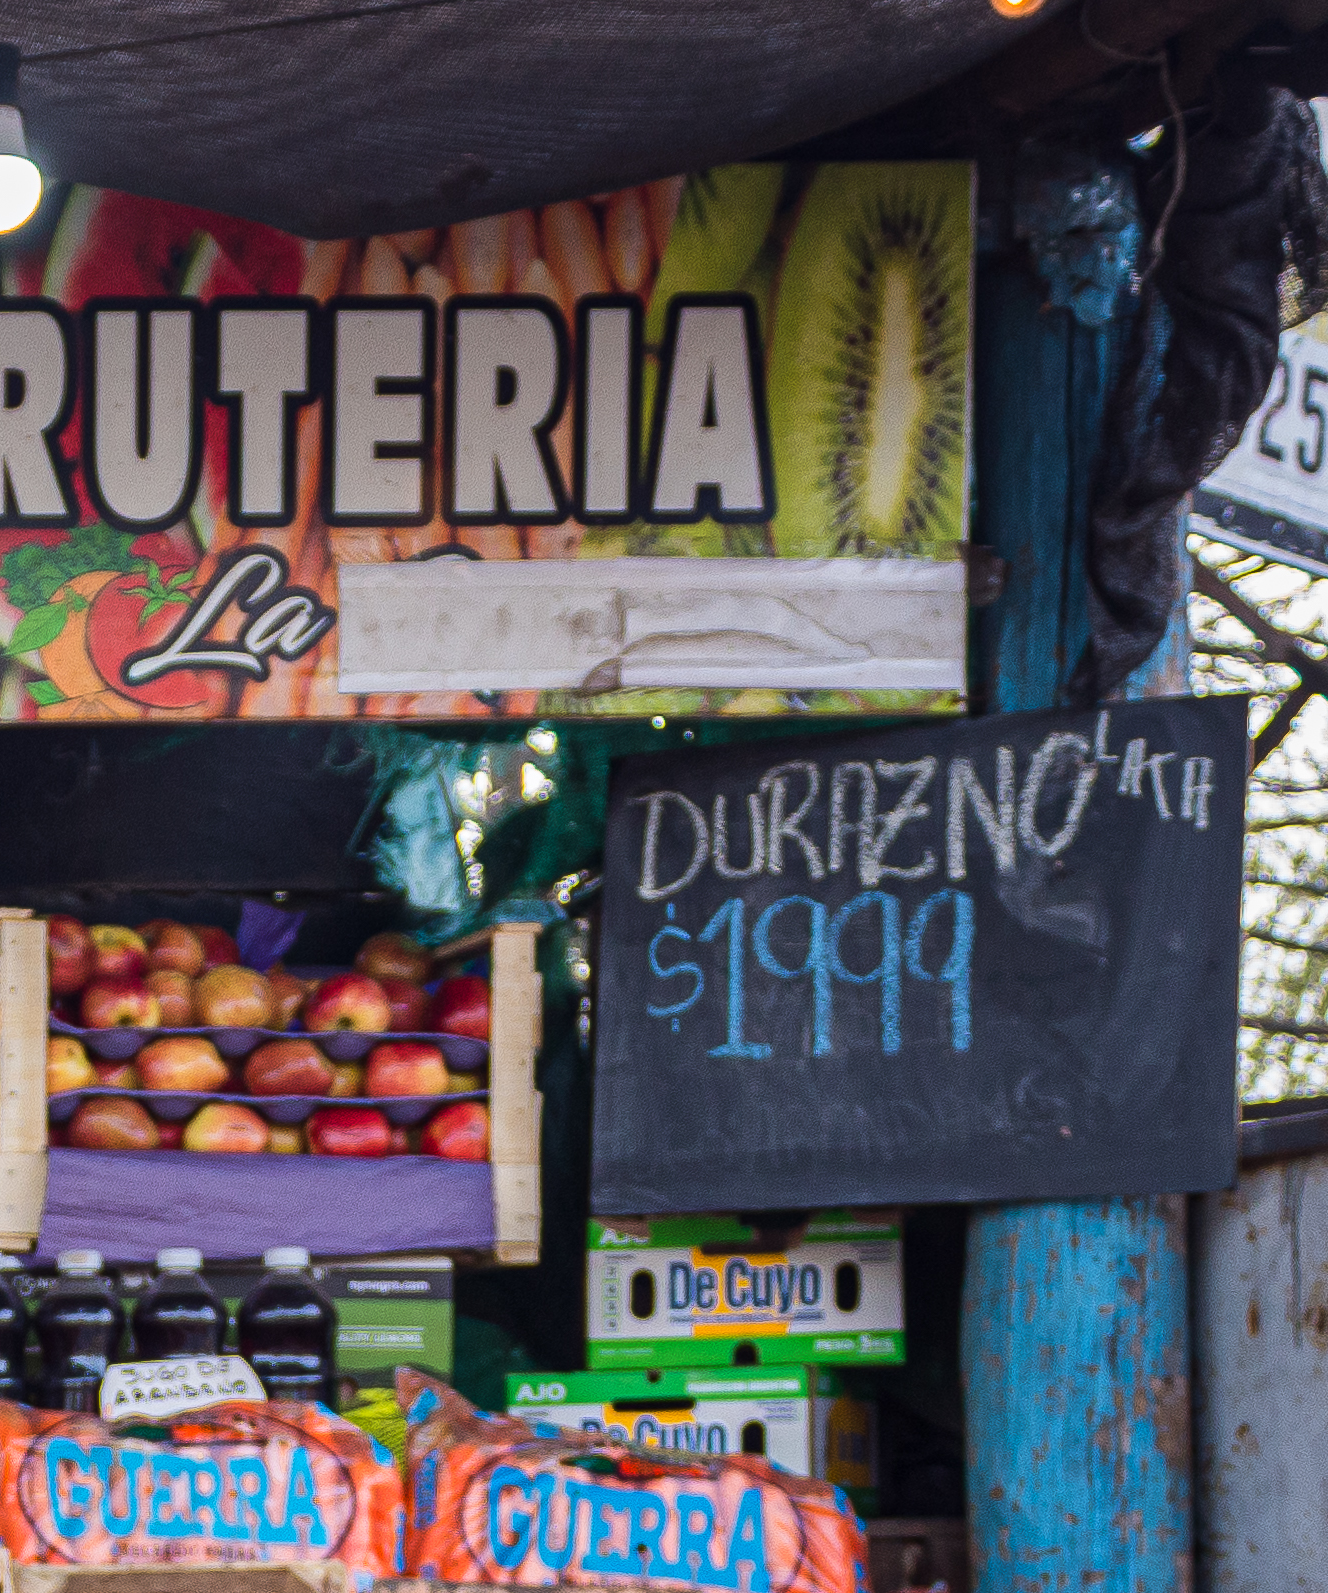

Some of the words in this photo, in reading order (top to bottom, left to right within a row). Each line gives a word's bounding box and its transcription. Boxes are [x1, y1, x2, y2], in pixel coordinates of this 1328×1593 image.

[125, 550, 335, 688] La
[637, 730, 1097, 902] DURAZNO
[645, 887, 975, 1060] $1999
[668, 1259, 719, 1312] De
[724, 1256, 823, 1315] Cuyo
[516, 1382, 567, 1402] AJO
[45, 1435, 330, 1548] GUERRA
